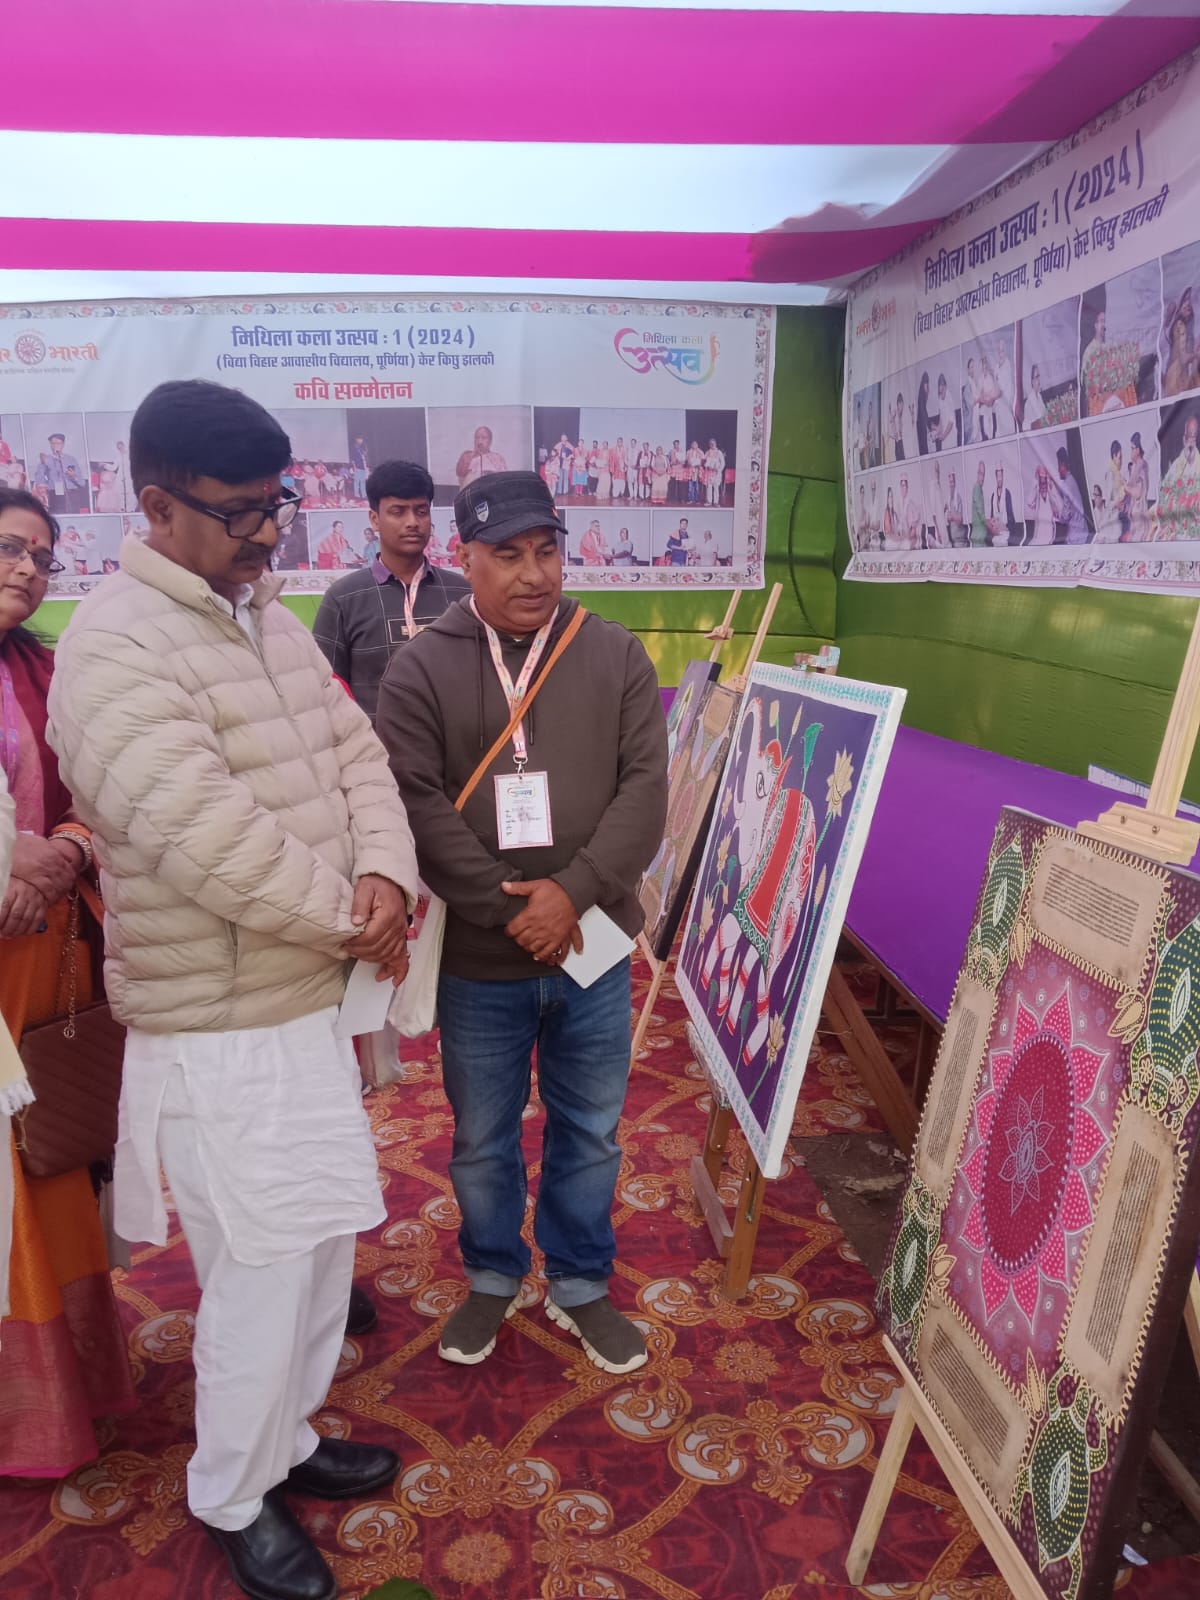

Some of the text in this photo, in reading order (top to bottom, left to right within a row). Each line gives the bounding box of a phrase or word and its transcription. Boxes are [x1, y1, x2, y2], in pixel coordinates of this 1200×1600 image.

[924, 246, 966, 295] मिथिला
[967, 226, 997, 269] कला
[1000, 201, 1040, 254] उत्सव
[1064, 128, 1145, 225] (2024)
[933, 302, 955, 328] विहार
[1073, 227, 1090, 260] केर
[231, 325, 293, 347] मिथिला
[295, 329, 332, 346] कला
[335, 329, 379, 346] उत्सव
[407, 325, 475, 349] (2024)
[642, 332, 677, 345] मिथिला
[48, 342, 100, 362] भारती
[249, 353, 278, 368] विहार
[281, 353, 327, 368] आवासीय
[329, 352, 374, 369] विद्यालय,
[417, 351, 435, 366] केर
[461, 351, 496, 366] झलकी
[293, 376, 413, 400] कवि सम्मेलन
